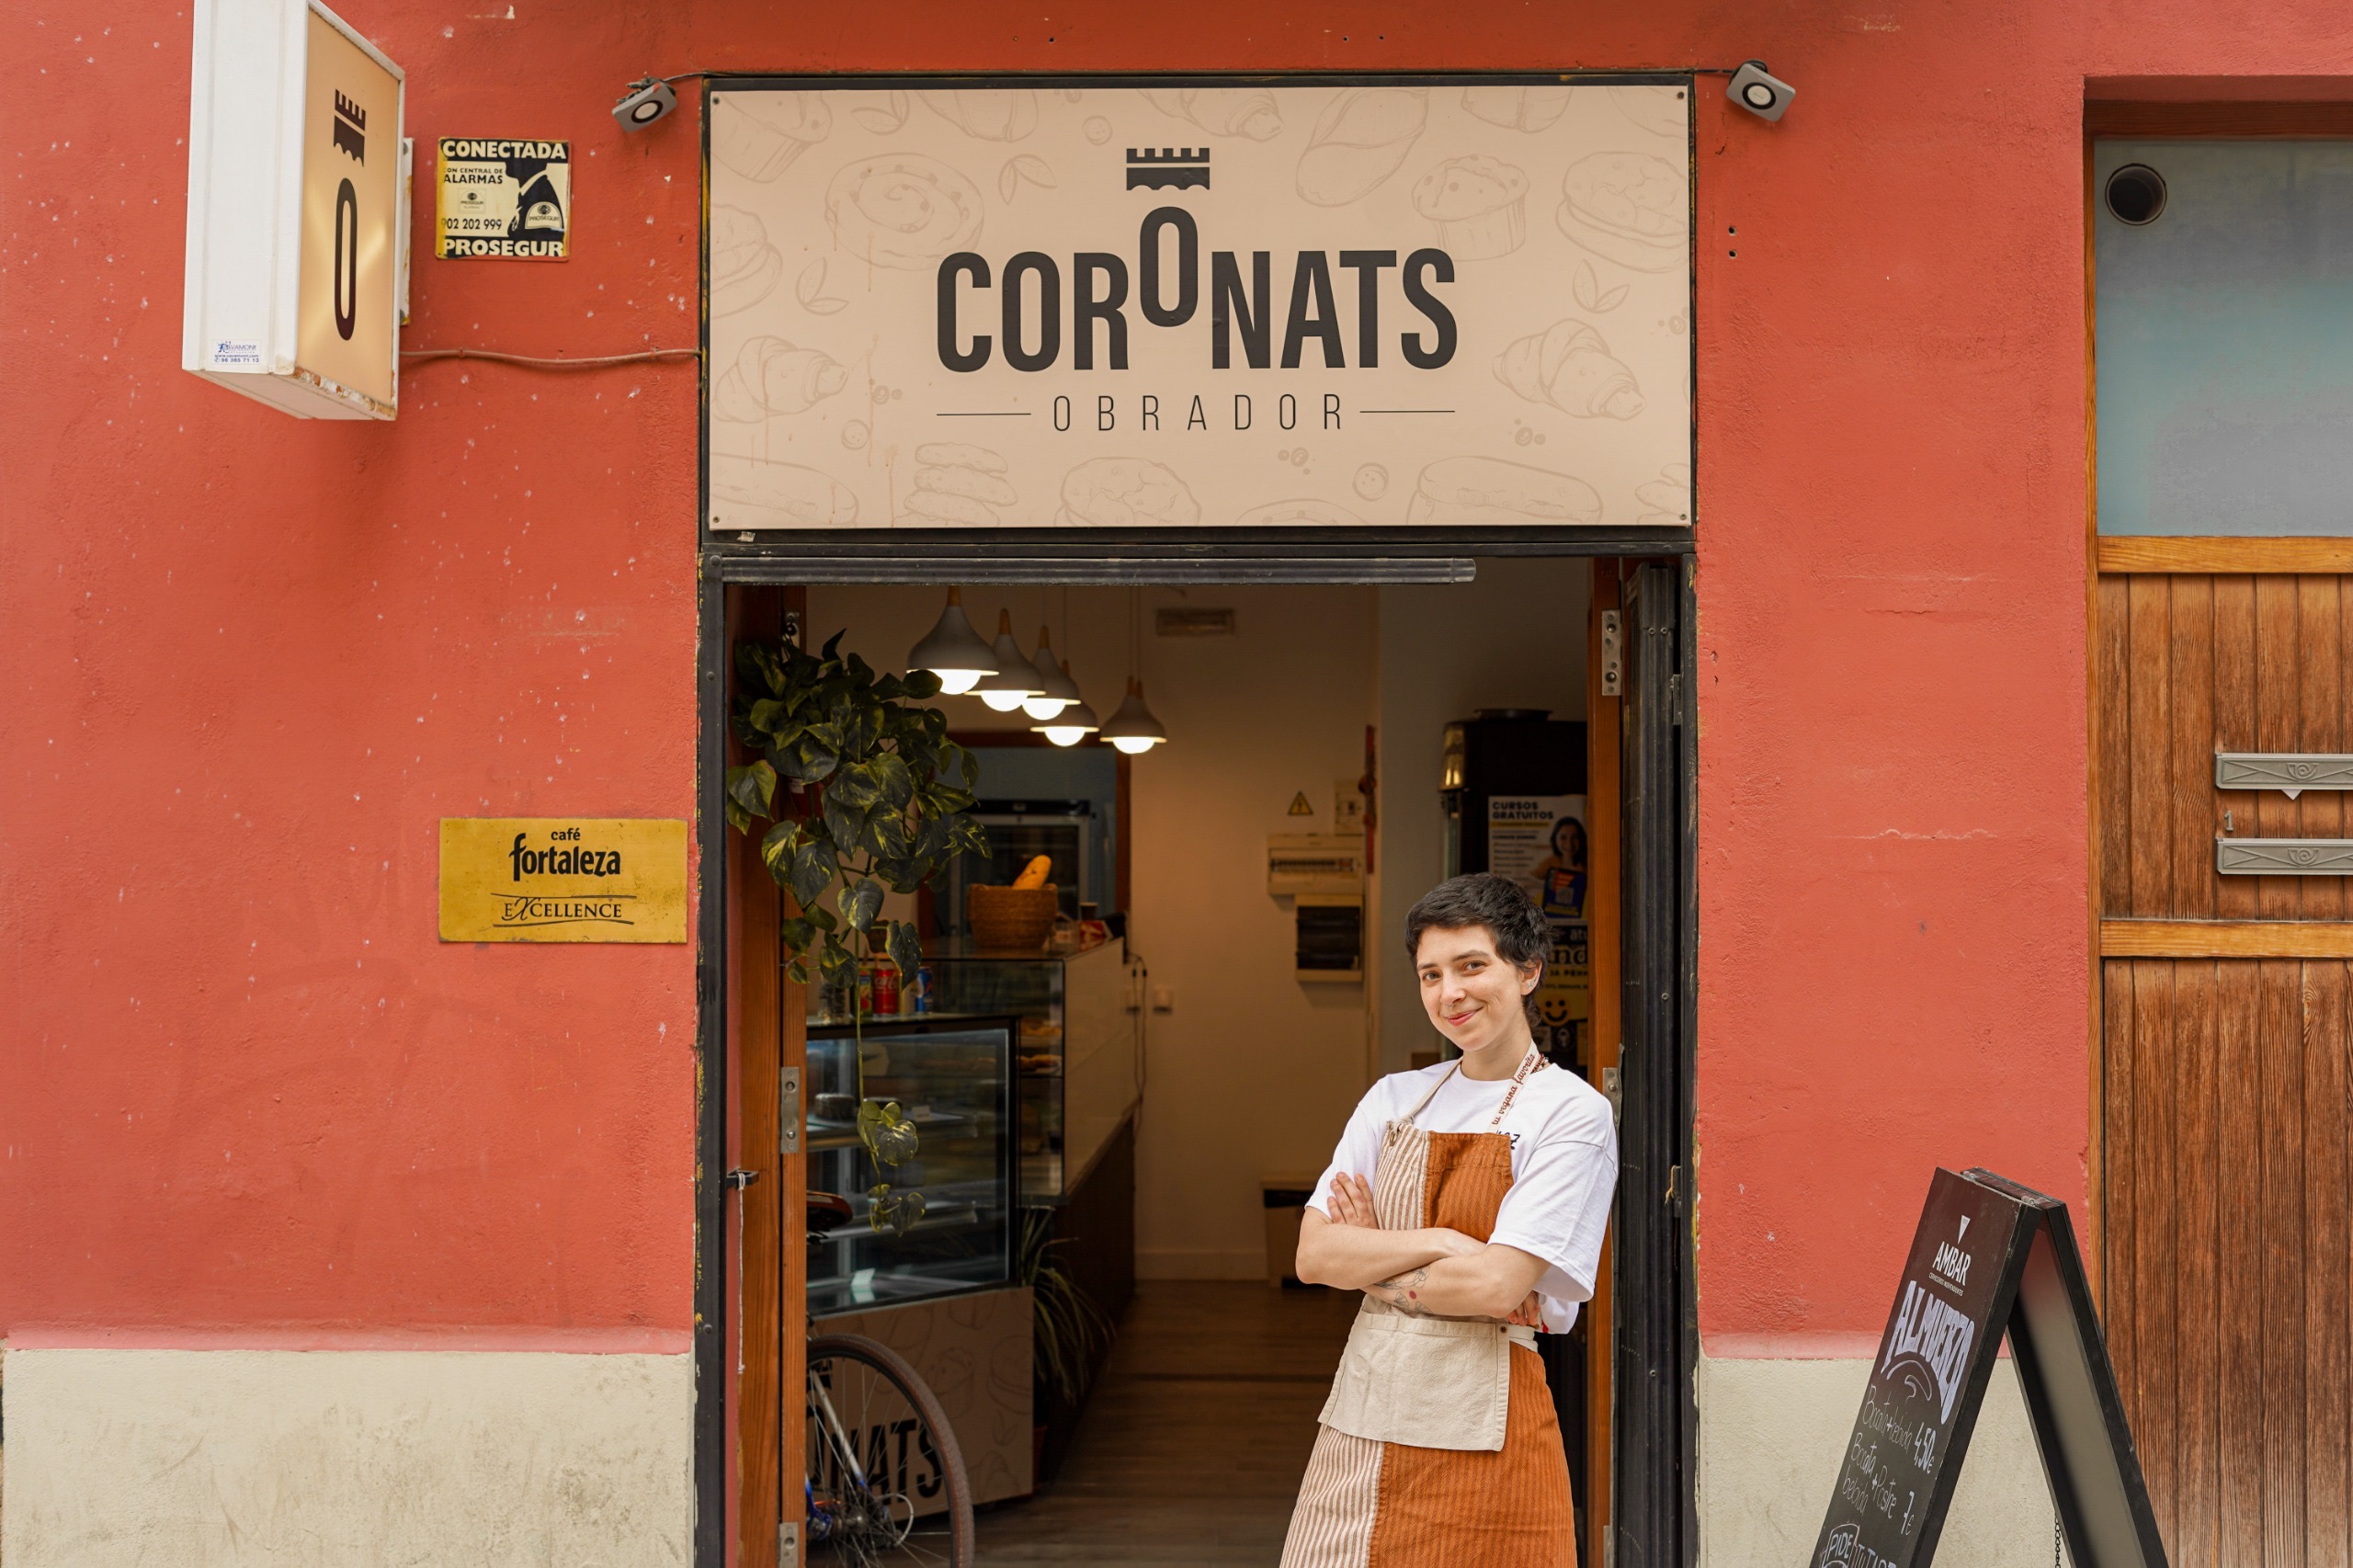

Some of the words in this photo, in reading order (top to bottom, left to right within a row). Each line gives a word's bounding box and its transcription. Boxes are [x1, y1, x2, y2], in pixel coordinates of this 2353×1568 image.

[442, 140, 567, 160] CONECTADA
[444, 174, 504, 185] ALARMAS
[462, 217, 481, 230] 202
[483, 218, 503, 231] 999
[444, 239, 564, 258] PROSEGUR
[937, 205, 1458, 373] CORONATS
[1052, 393, 1342, 432] OBRADOR
[1492, 801, 1539, 810] CURSOS
[1492, 811, 1554, 820] GRATUITOS
[2223, 810, 2234, 832] 1
[551, 828, 581, 841] café
[508, 833, 621, 882] fortaleza
[501, 897, 622, 921] EXCELLENCE
[1492, 1116, 1501, 1126] tu
[1498, 1085, 1518, 1115] vegana
[1512, 1053, 1536, 1085] favorita
[1932, 1241, 1972, 1287] AMBAR
[1881, 1280, 1975, 1426] ALMUERZO
[1826, 1531, 1854, 1562] PIDE
